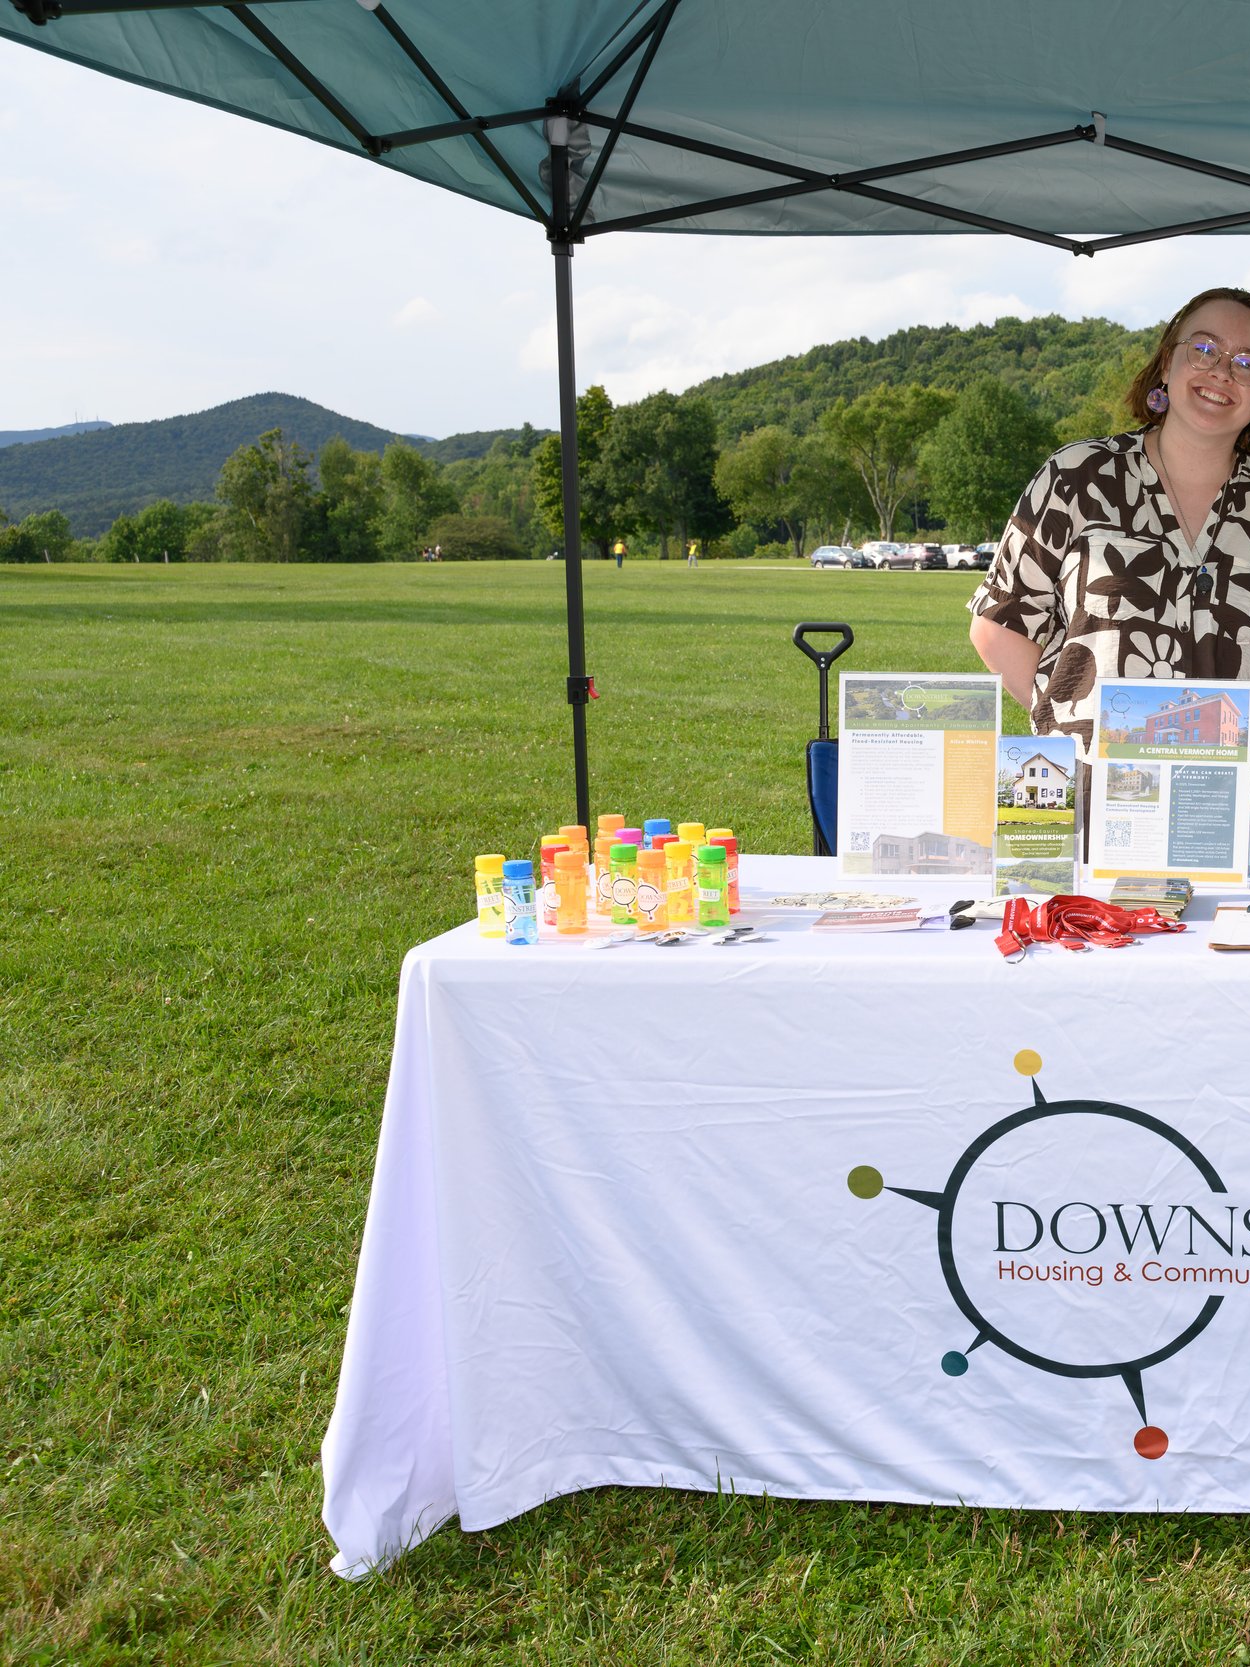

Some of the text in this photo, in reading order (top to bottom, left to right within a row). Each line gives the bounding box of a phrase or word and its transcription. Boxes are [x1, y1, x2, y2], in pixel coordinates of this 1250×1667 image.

[1146, 747, 1178, 755] CENTRAL
[1180, 748, 1216, 756] VERMONT
[1216, 749, 1239, 757] HOME
[998, 1260, 1103, 1285] Housing
[1114, 1263, 1133, 1282] &
